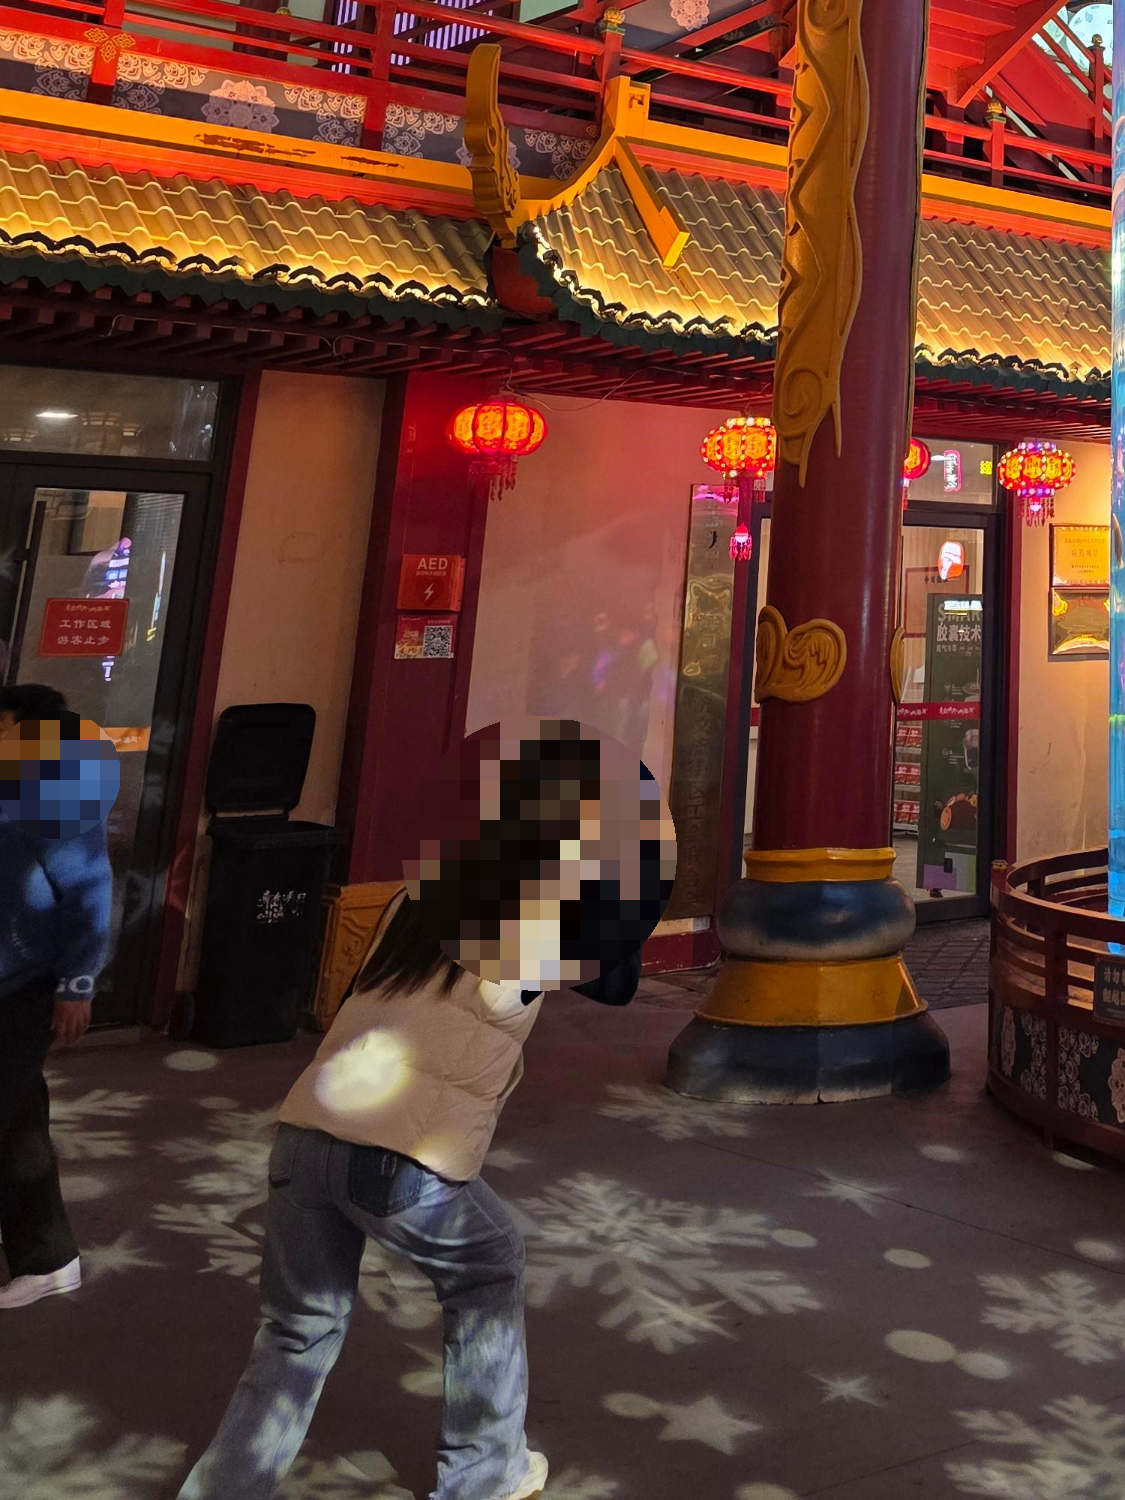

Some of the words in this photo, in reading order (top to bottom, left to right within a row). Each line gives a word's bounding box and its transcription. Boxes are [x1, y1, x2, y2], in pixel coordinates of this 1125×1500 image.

[417, 557, 448, 570] AED
[59, 619, 112, 629] 工作区域
[936, 623, 982, 642] 胶囊技术
[56, 635, 110, 646] 游客止步
